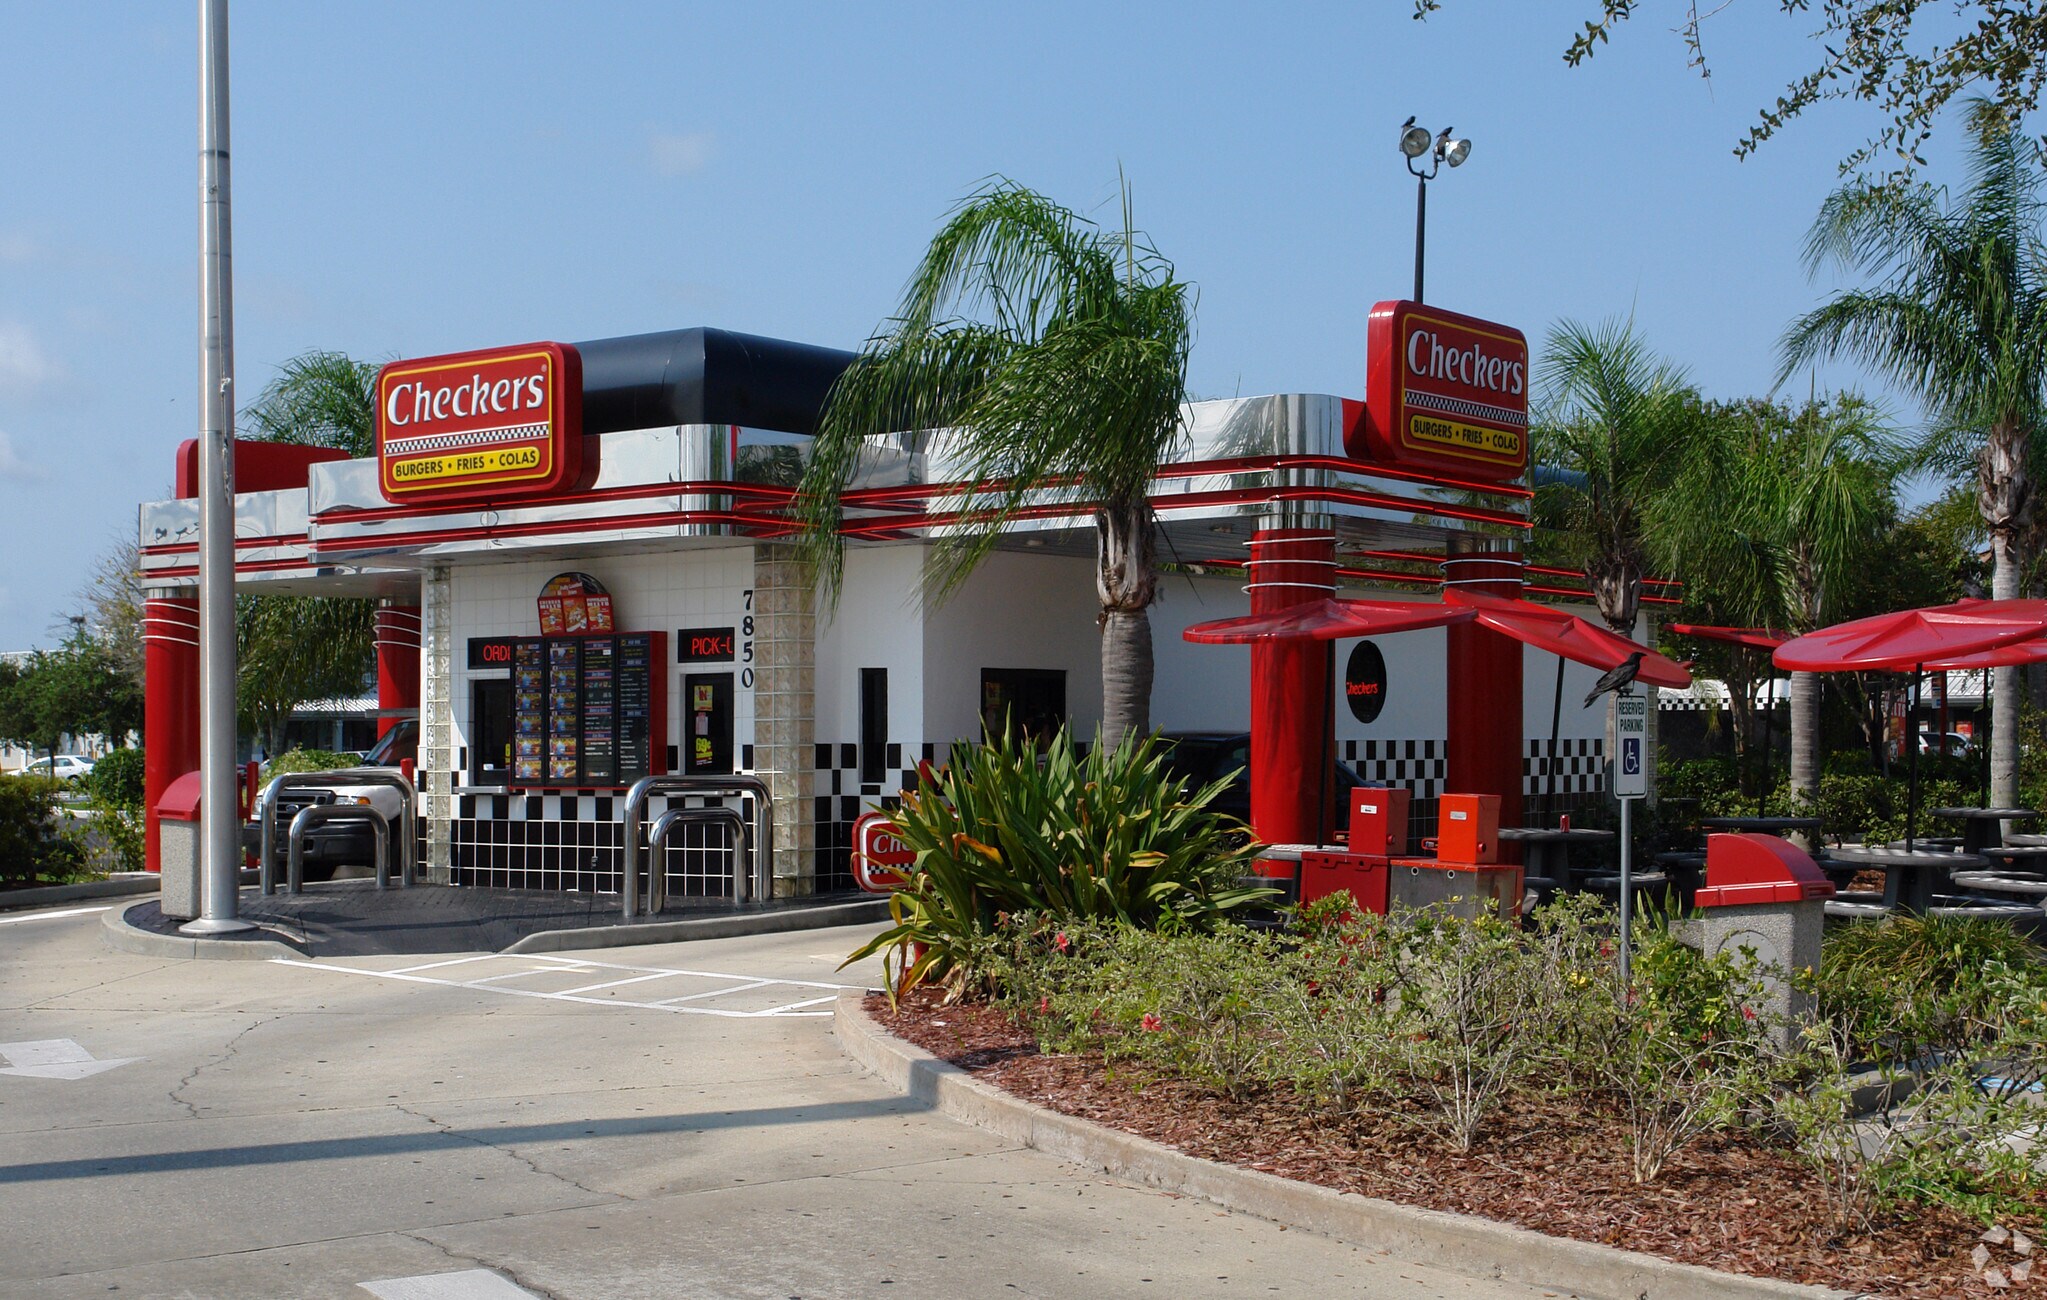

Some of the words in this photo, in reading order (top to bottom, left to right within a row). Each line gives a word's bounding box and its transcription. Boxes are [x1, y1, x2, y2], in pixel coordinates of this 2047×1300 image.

[1407, 329, 1523, 395] Checkers
[387, 374, 544, 426] Checkers
[1413, 419, 1452, 439] BURGERS
[1462, 428, 1482, 444] FRIES
[1492, 434, 1518, 450] COLAS
[395, 459, 443, 477] BURGERS
[456, 456, 485, 471] FRIES
[499, 450, 536, 467] COLAS
[741, 589, 755, 689] 7850
[1618, 702, 1644, 715] RESERVED
[1620, 719, 1643, 732] PARKING
